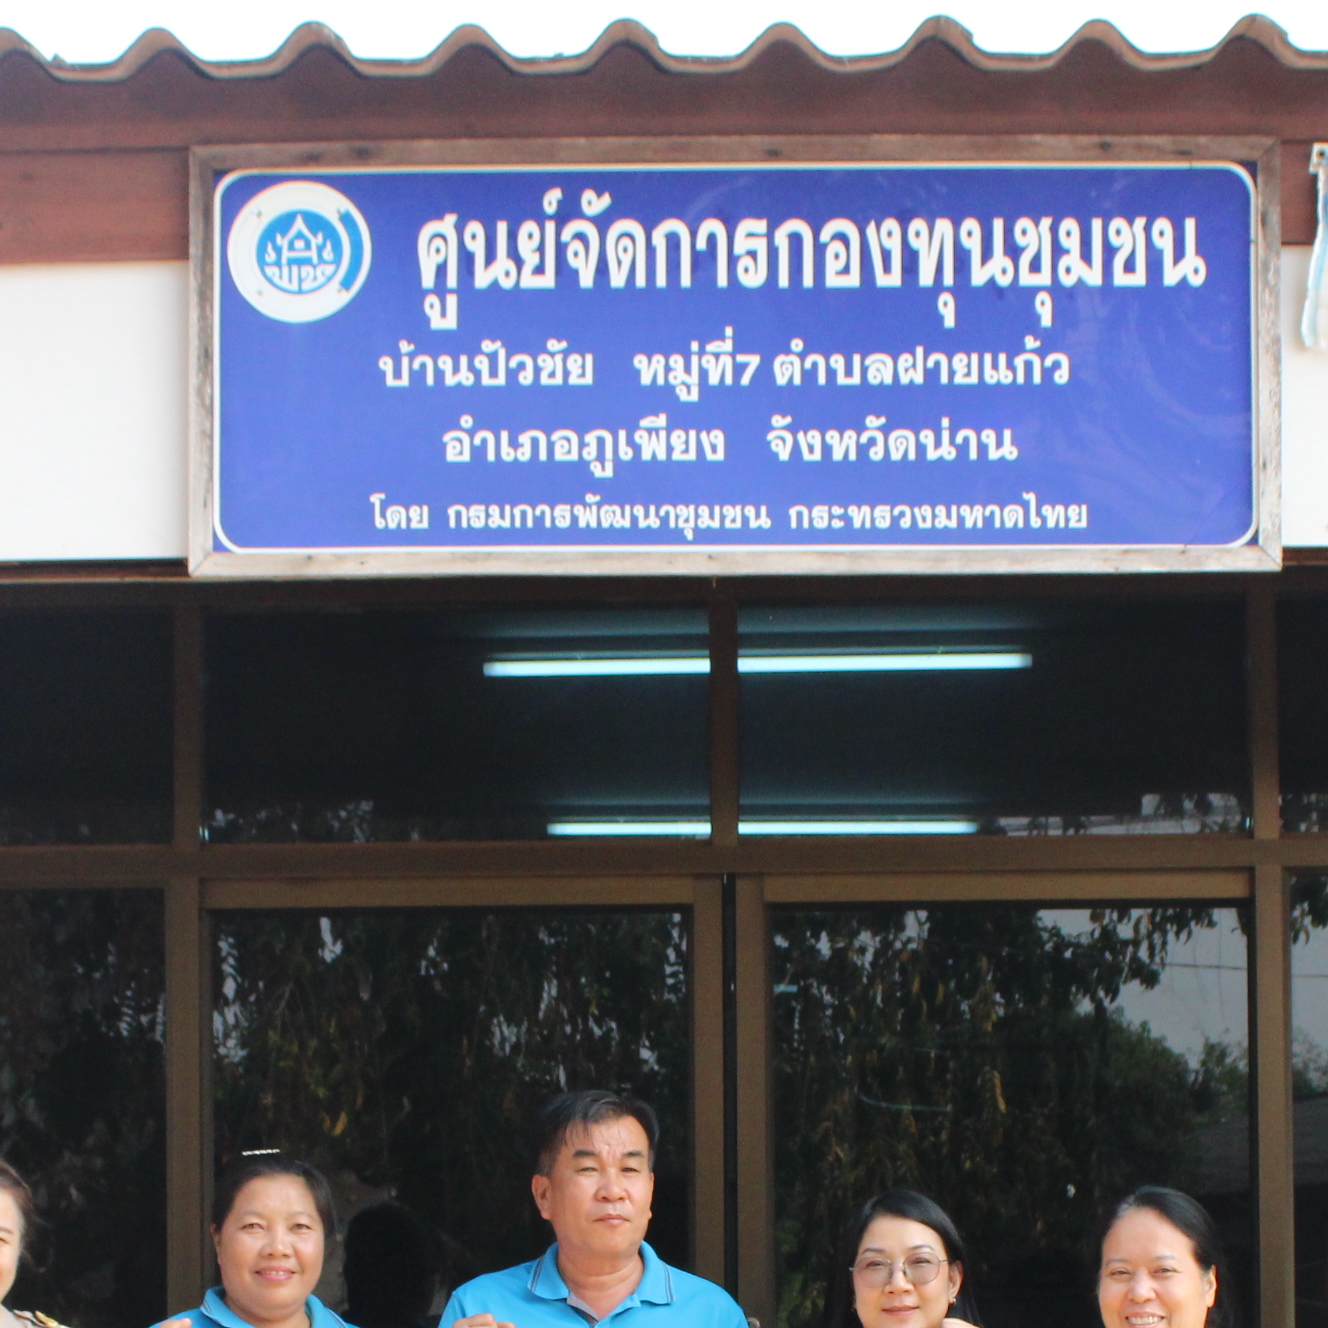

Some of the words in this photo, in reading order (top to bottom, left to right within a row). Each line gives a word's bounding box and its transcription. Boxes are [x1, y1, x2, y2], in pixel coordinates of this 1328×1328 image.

[416, 186, 1208, 332] ศูนย์จัดการกองทุนชุมชน
[377, 338, 595, 387] บ้านปัวชัย
[632, 329, 761, 403] หมู่ที่7
[772, 334, 1071, 386] ตำบลฝายแก้ว
[441, 413, 727, 479] อำเภอภูเพียง
[766, 414, 1020, 462] จังหวัดน่าน
[369, 492, 430, 530] โดย
[446, 493, 772, 541] กรมการพัฒนาชุมชน
[788, 491, 1089, 530] กระทรวงมหาดไทย
